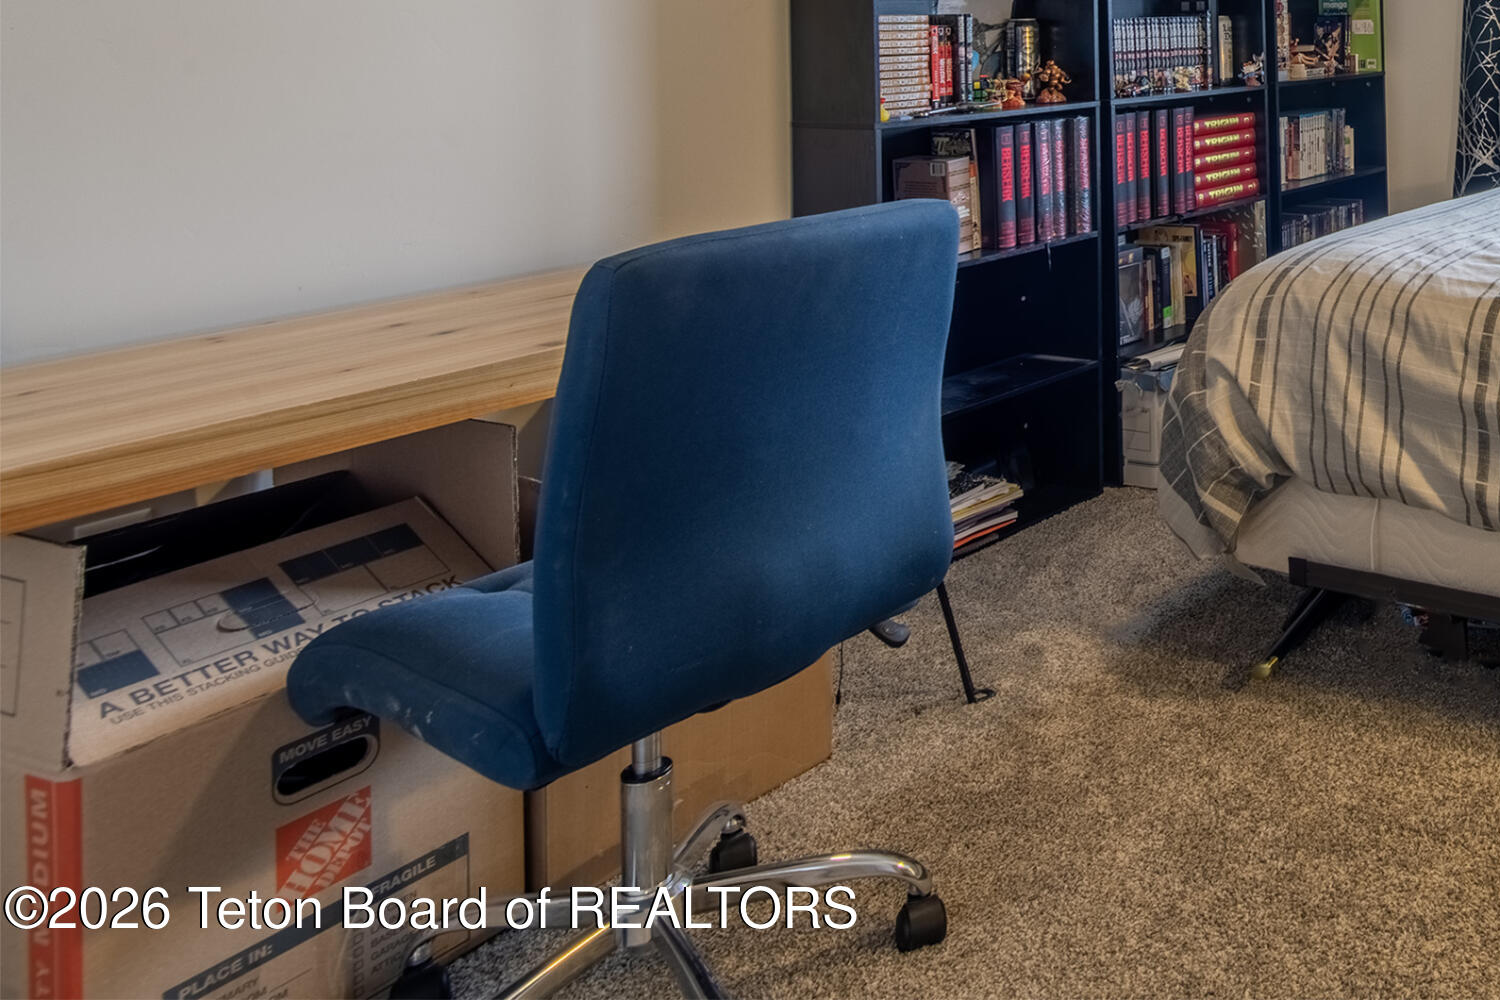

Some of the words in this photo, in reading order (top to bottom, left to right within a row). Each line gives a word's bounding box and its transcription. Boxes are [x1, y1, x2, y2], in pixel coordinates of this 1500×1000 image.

[100, 701, 122, 719] A
[129, 650, 259, 705] BETTER
[262, 623, 325, 655] WAY
[110, 706, 145, 725] USE
[148, 692, 185, 711] THIS
[187, 664, 262, 696] STACKING
[279, 733, 329, 764] MOVE
[331, 715, 373, 743] EASY
[30, 787, 51, 947] MDIUM
[275, 794, 372, 905] HOME
[286, 818, 327, 862] THE
[314, 815, 372, 889] DEPOT
[371, 855, 438, 899] FRAGILE
[177, 960, 243, 1000] PLACE
[247, 942, 274, 964] IN:
